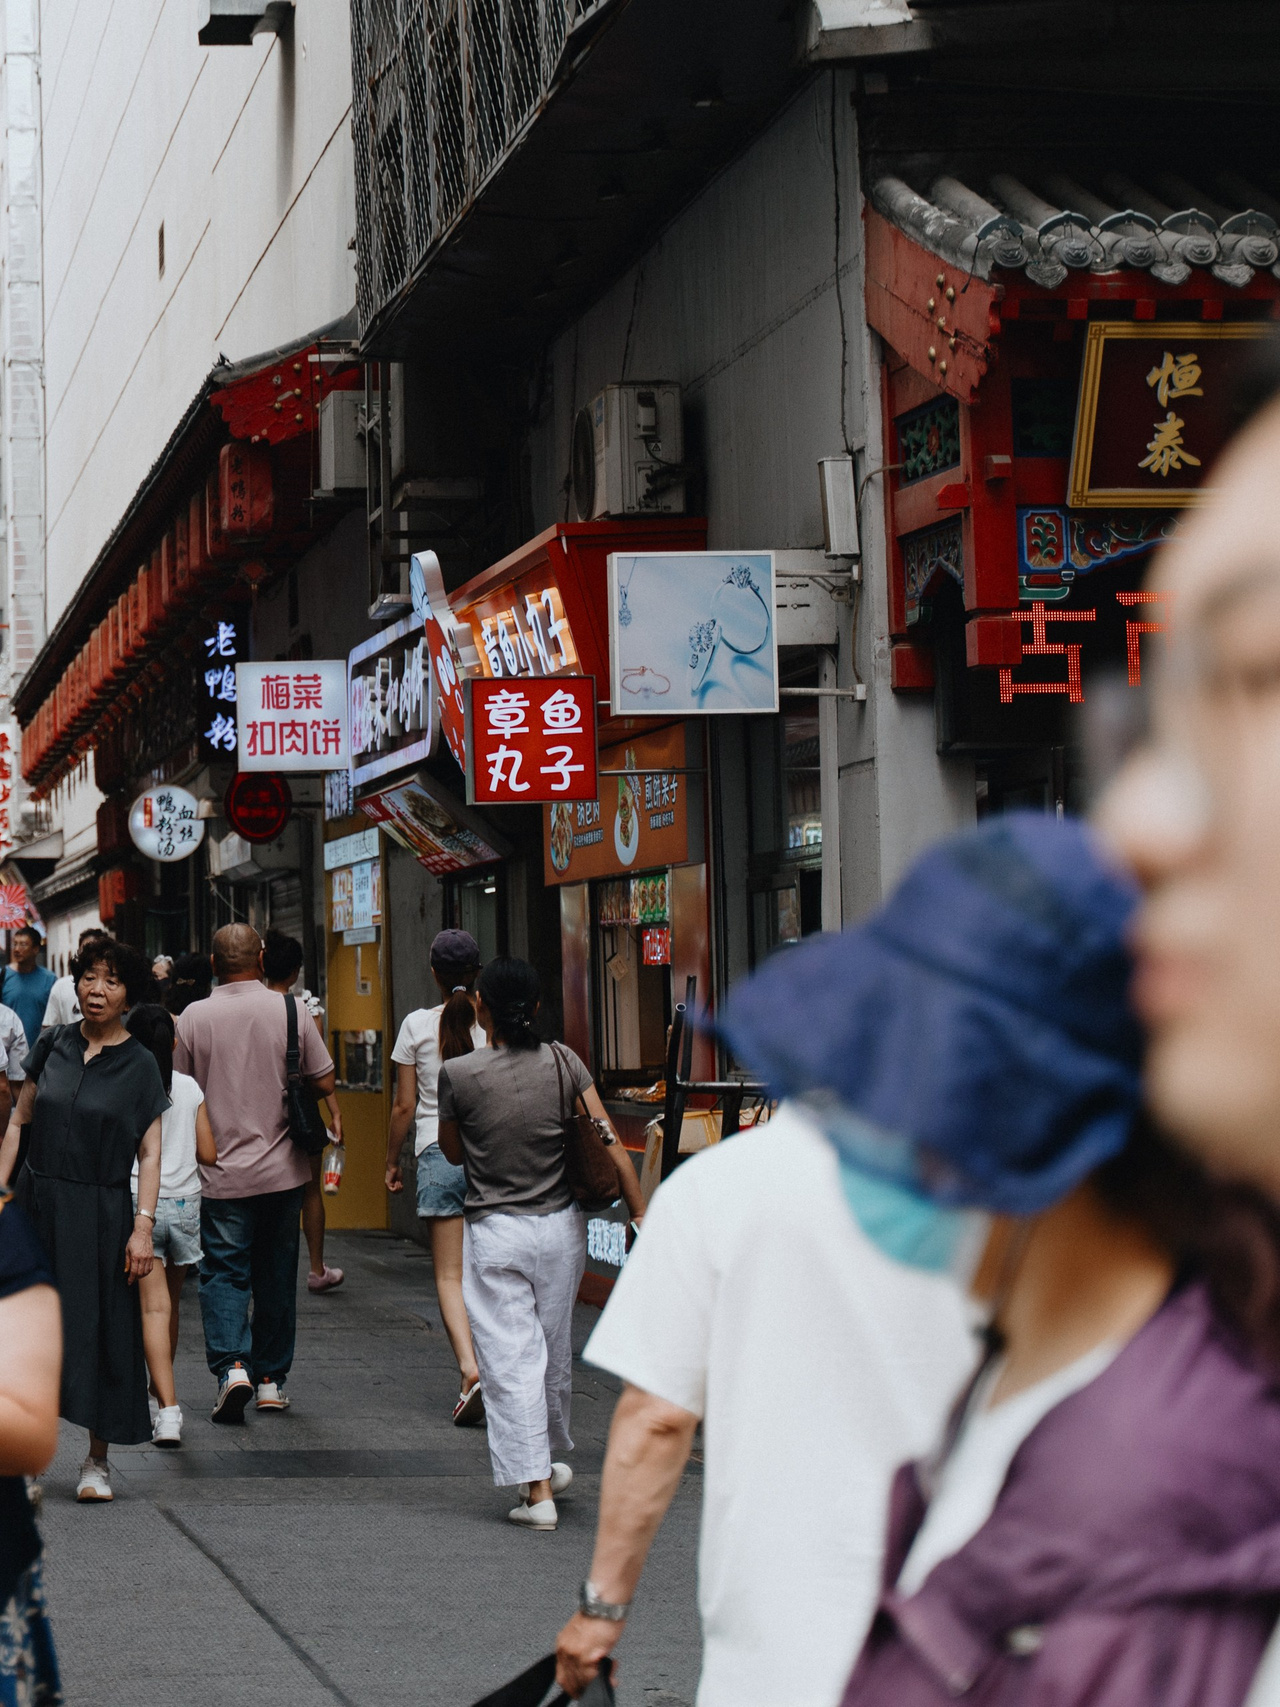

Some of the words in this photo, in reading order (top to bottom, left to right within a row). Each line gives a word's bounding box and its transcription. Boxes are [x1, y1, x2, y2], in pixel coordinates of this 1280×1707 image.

[1137, 350, 1204, 477] 恒泰
[204, 621, 237, 752] 老鸭粉
[261, 674, 322, 710] 梅菜
[246, 719, 341, 757] 扣肉饼
[484, 688, 583, 739] 章鱼
[486, 744, 585, 793] 丸子
